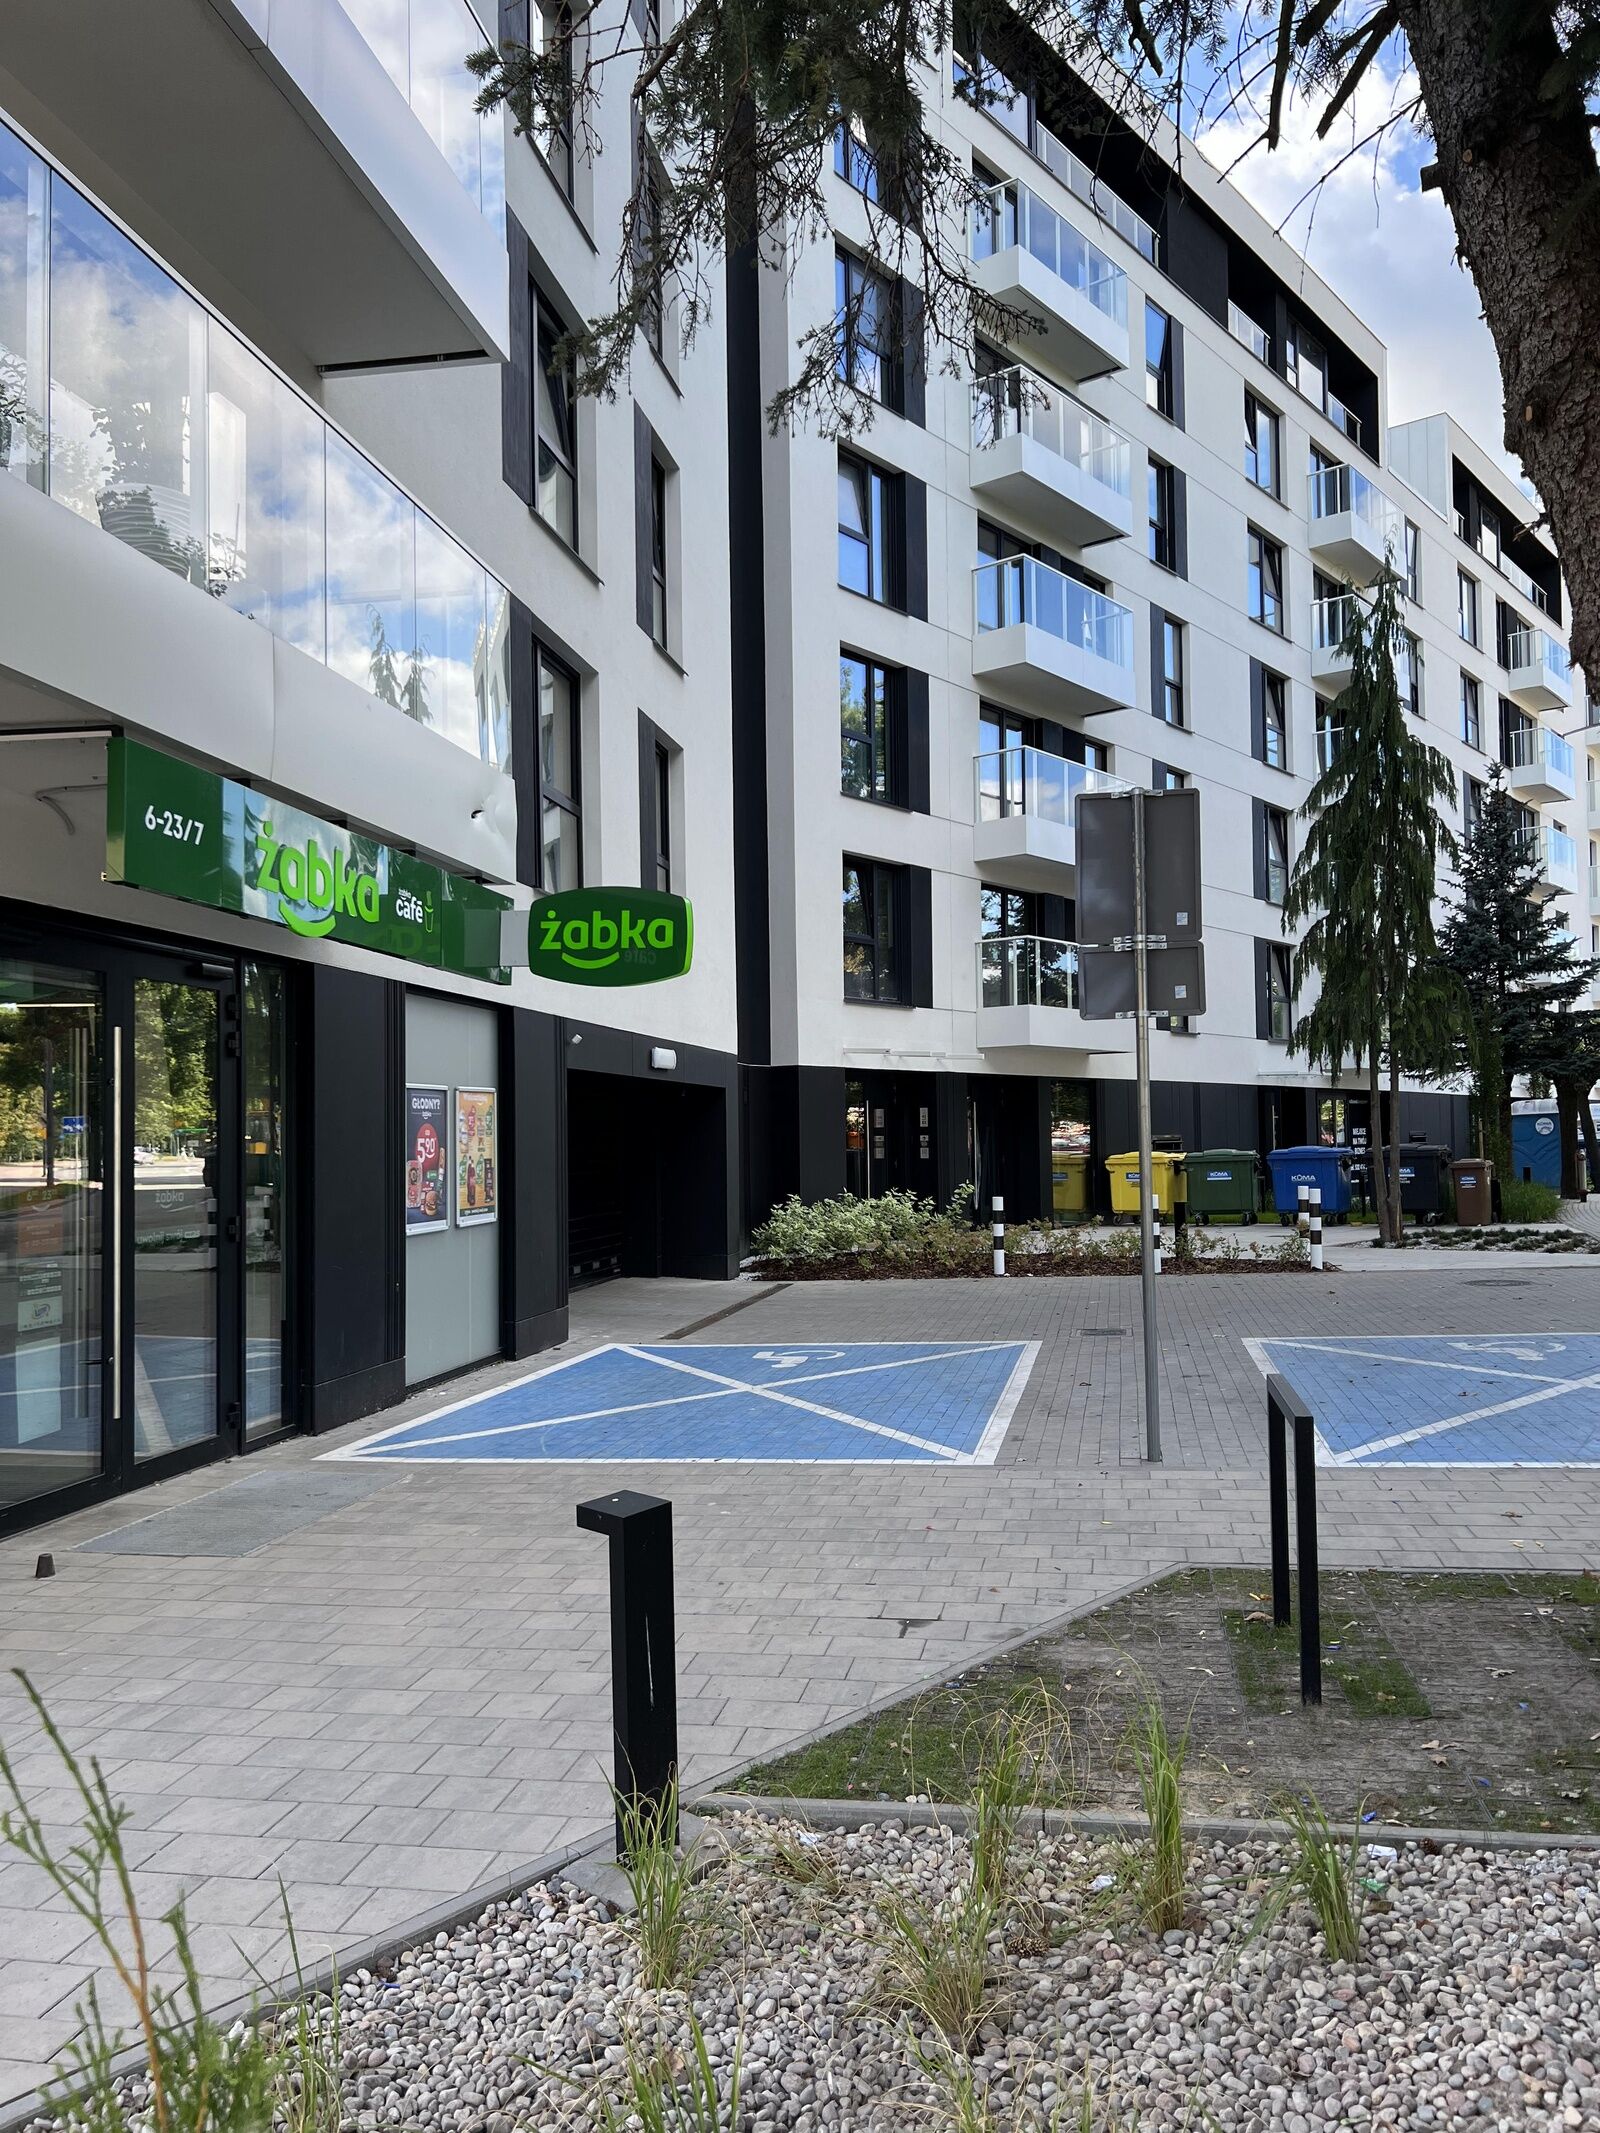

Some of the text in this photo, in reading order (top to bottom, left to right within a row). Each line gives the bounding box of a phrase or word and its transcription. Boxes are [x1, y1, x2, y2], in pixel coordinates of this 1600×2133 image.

[145, 805, 205, 845] 6-23/7
[255, 820, 380, 923] żabka
[539, 910, 674, 950] żabka
[411, 1097, 441, 1110] GŁODNY?
